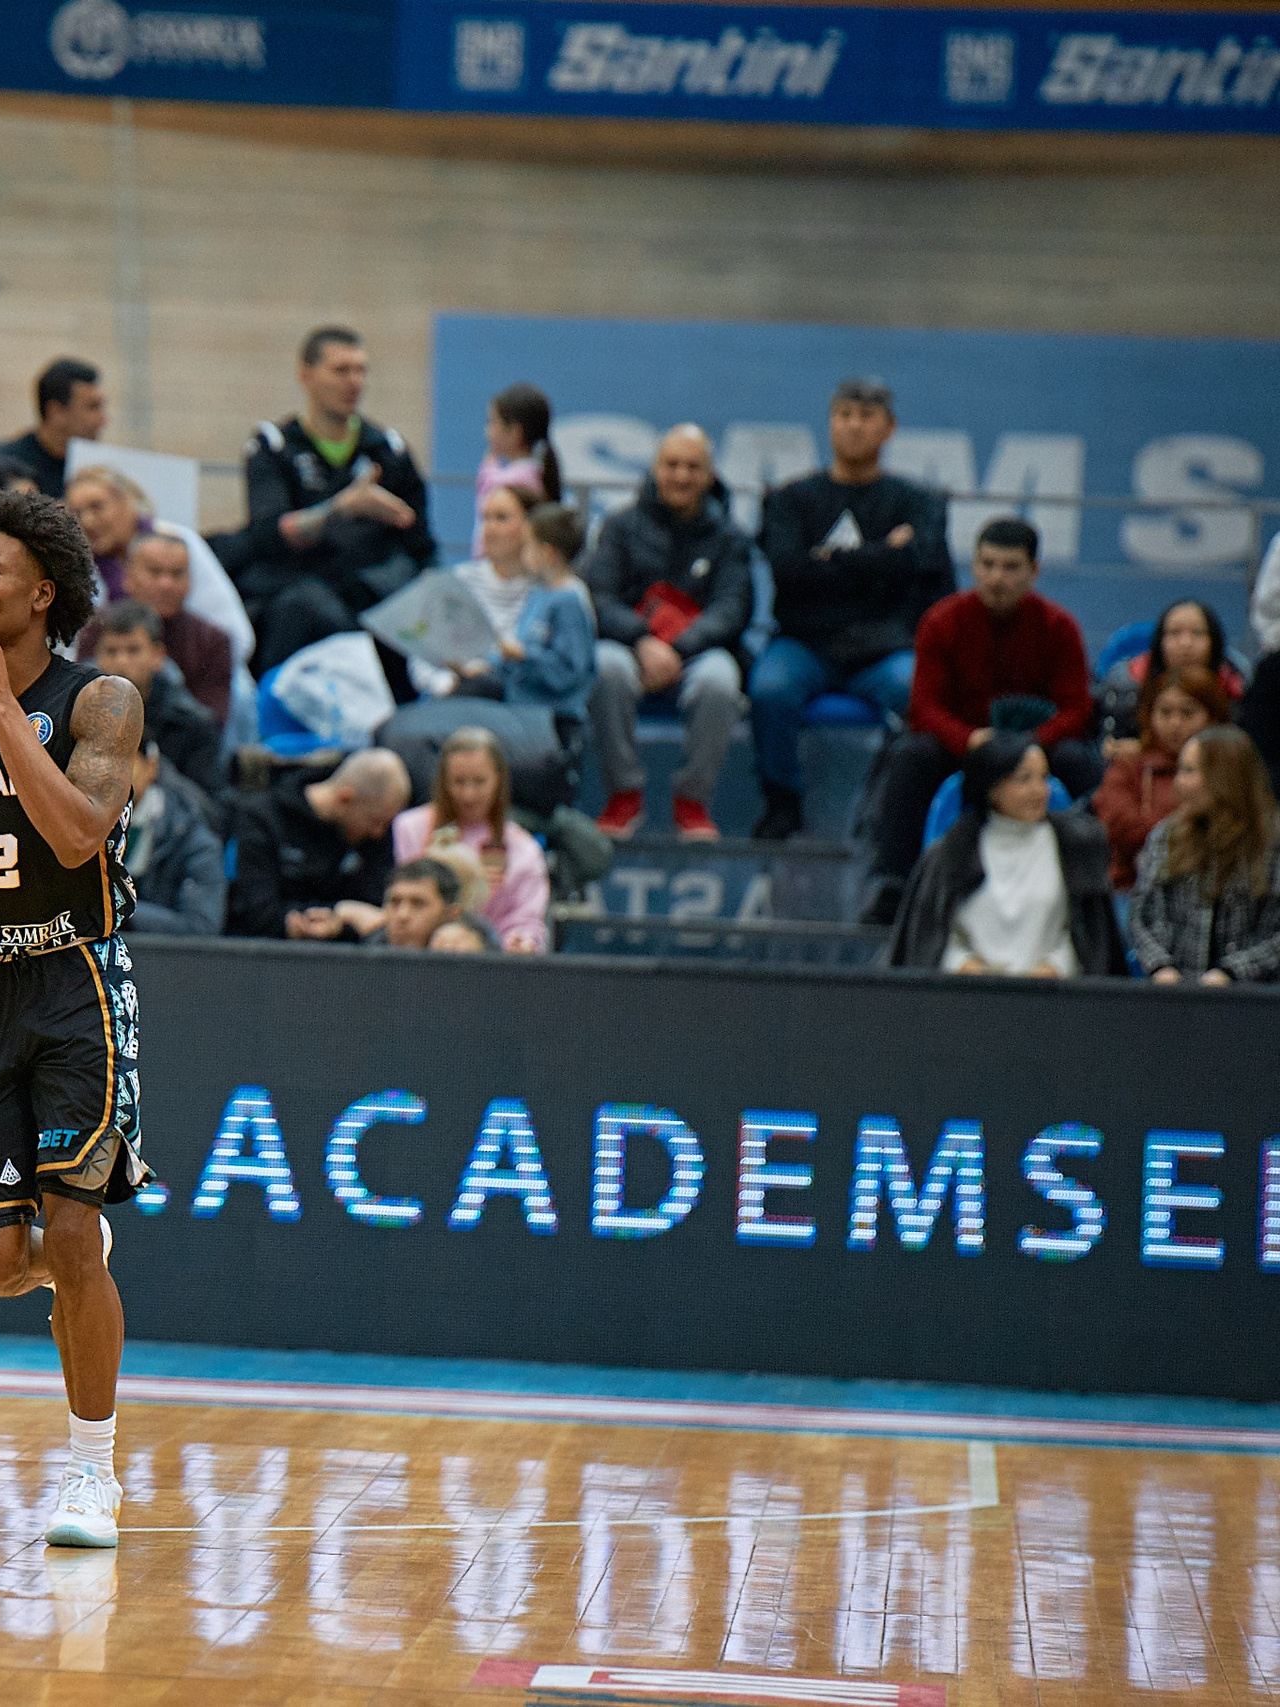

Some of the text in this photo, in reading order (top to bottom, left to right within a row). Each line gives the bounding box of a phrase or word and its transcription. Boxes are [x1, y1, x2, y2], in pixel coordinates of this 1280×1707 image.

[547, 22, 846, 97] Santini
[1, 913, 75, 943] SAMRUK
[39, 1129, 80, 1148] BET
